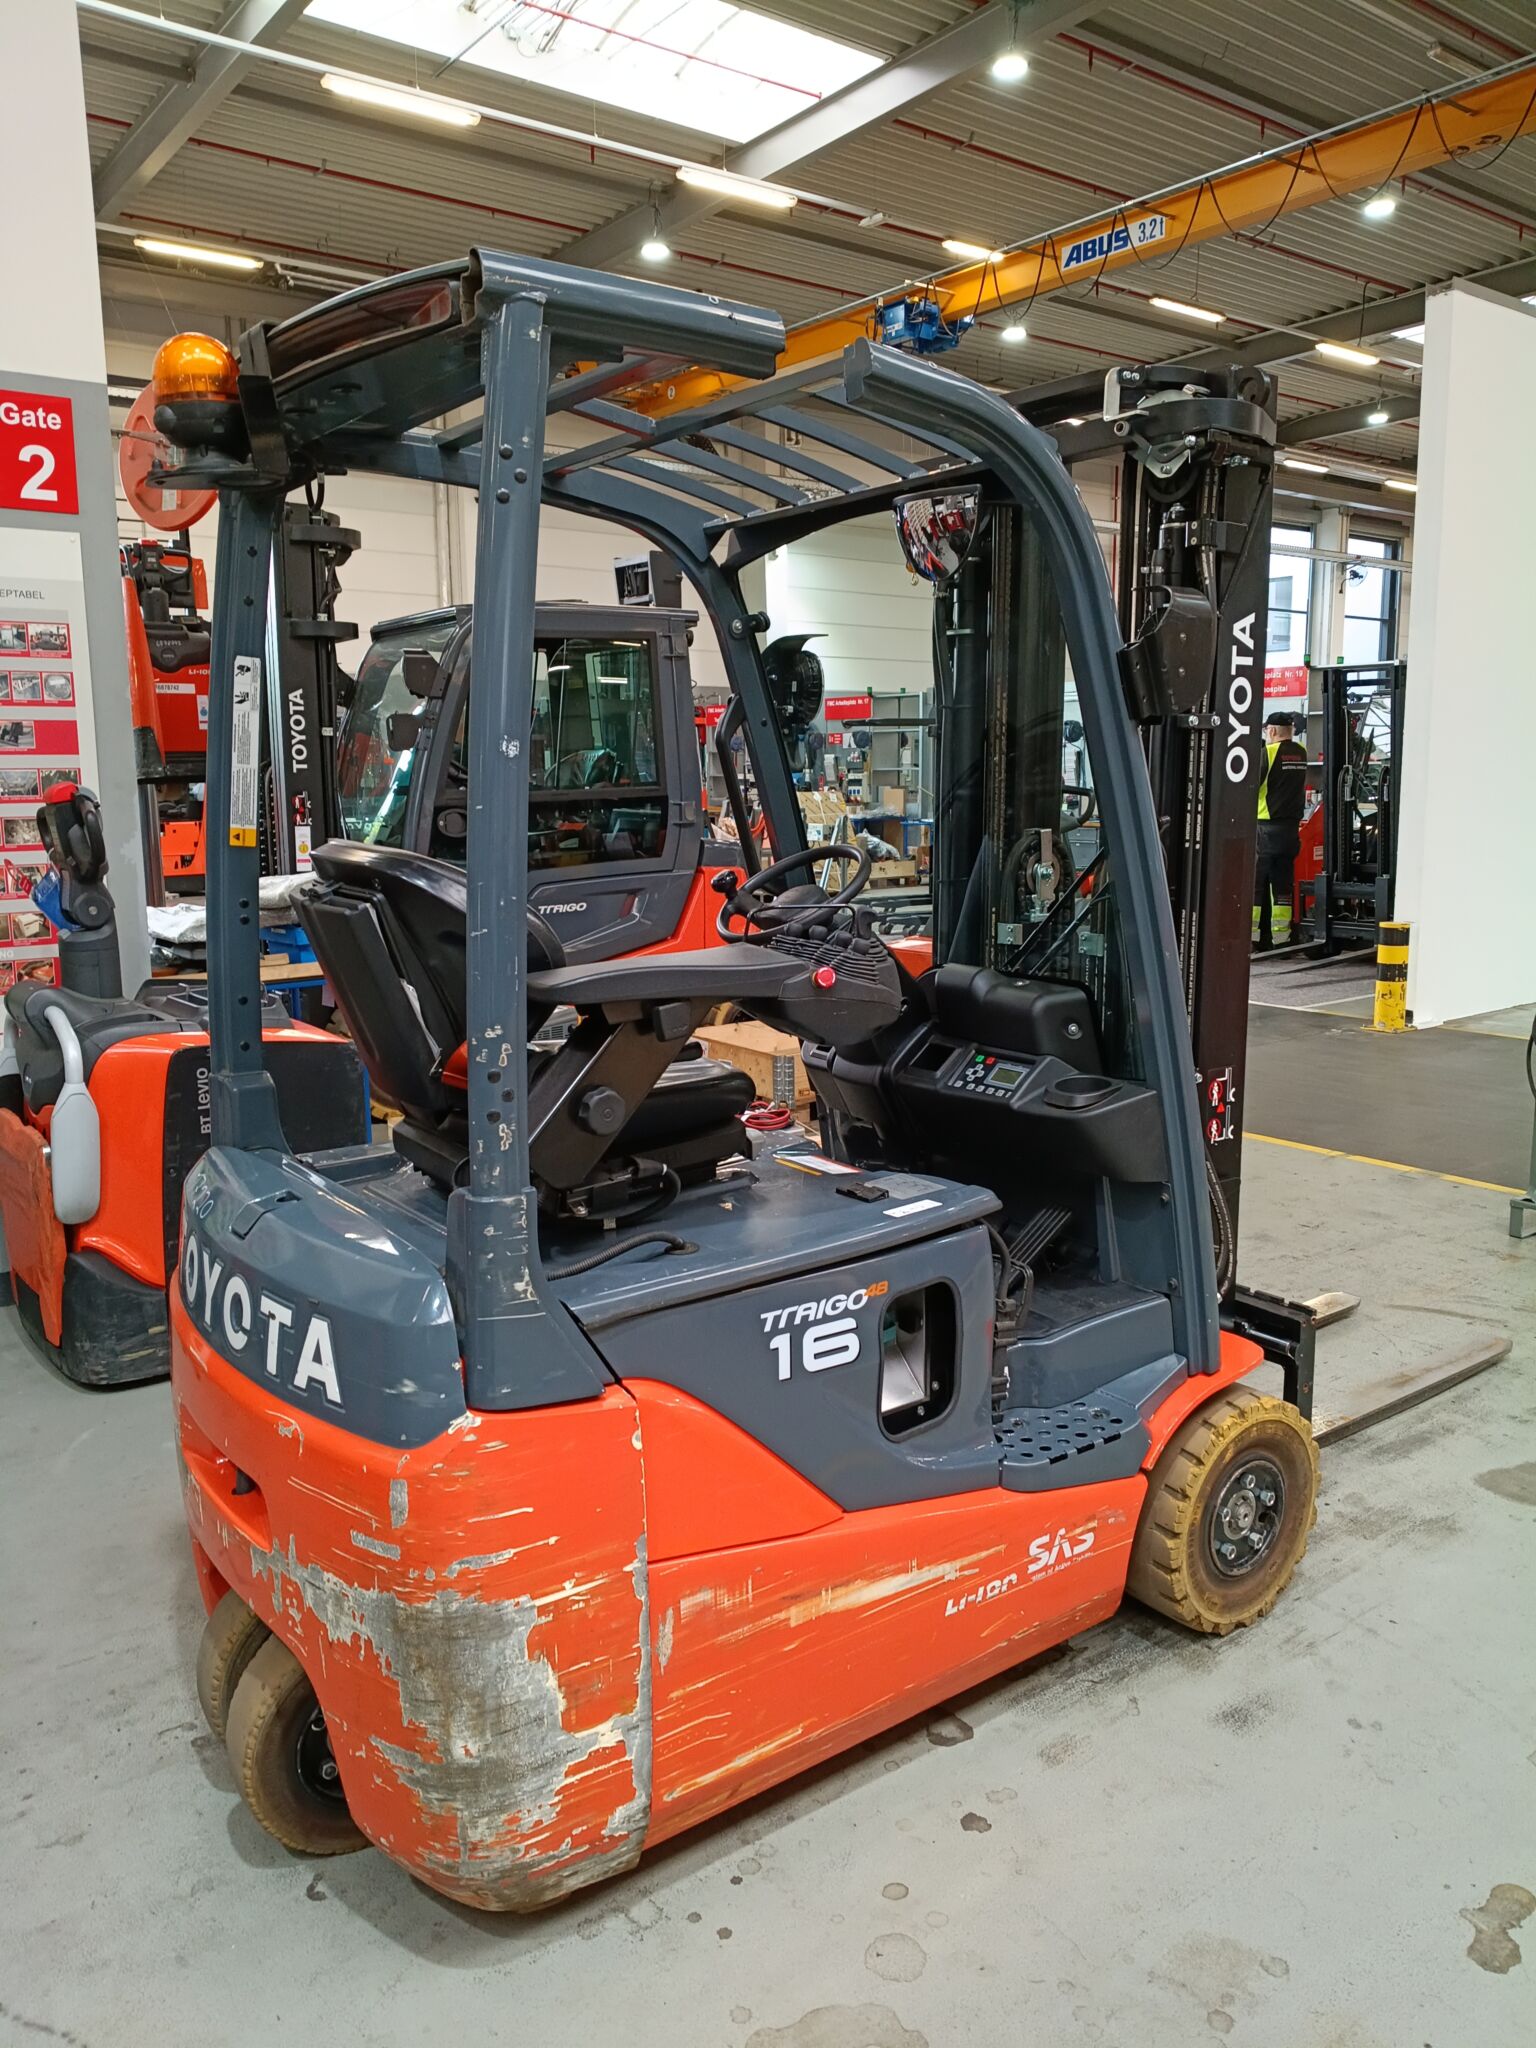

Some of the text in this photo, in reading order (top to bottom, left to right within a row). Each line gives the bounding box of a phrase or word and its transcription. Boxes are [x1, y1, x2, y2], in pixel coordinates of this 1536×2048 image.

[1063, 217, 1164, 268] ABUS 3,2 t
[0, 402, 62, 430] Gate
[18, 444, 58, 502] 2
[1284, 670, 1293, 678] Nr.
[1295, 669, 1303, 678] 19
[288, 688, 308, 773] TOYOTA
[538, 902, 587, 914] TRAIGO
[199, 1115, 211, 1134] BT
[760, 1287, 868, 1332] TRAIGO
[769, 1317, 860, 1381] 16
[1027, 1527, 1095, 1574] SAS
